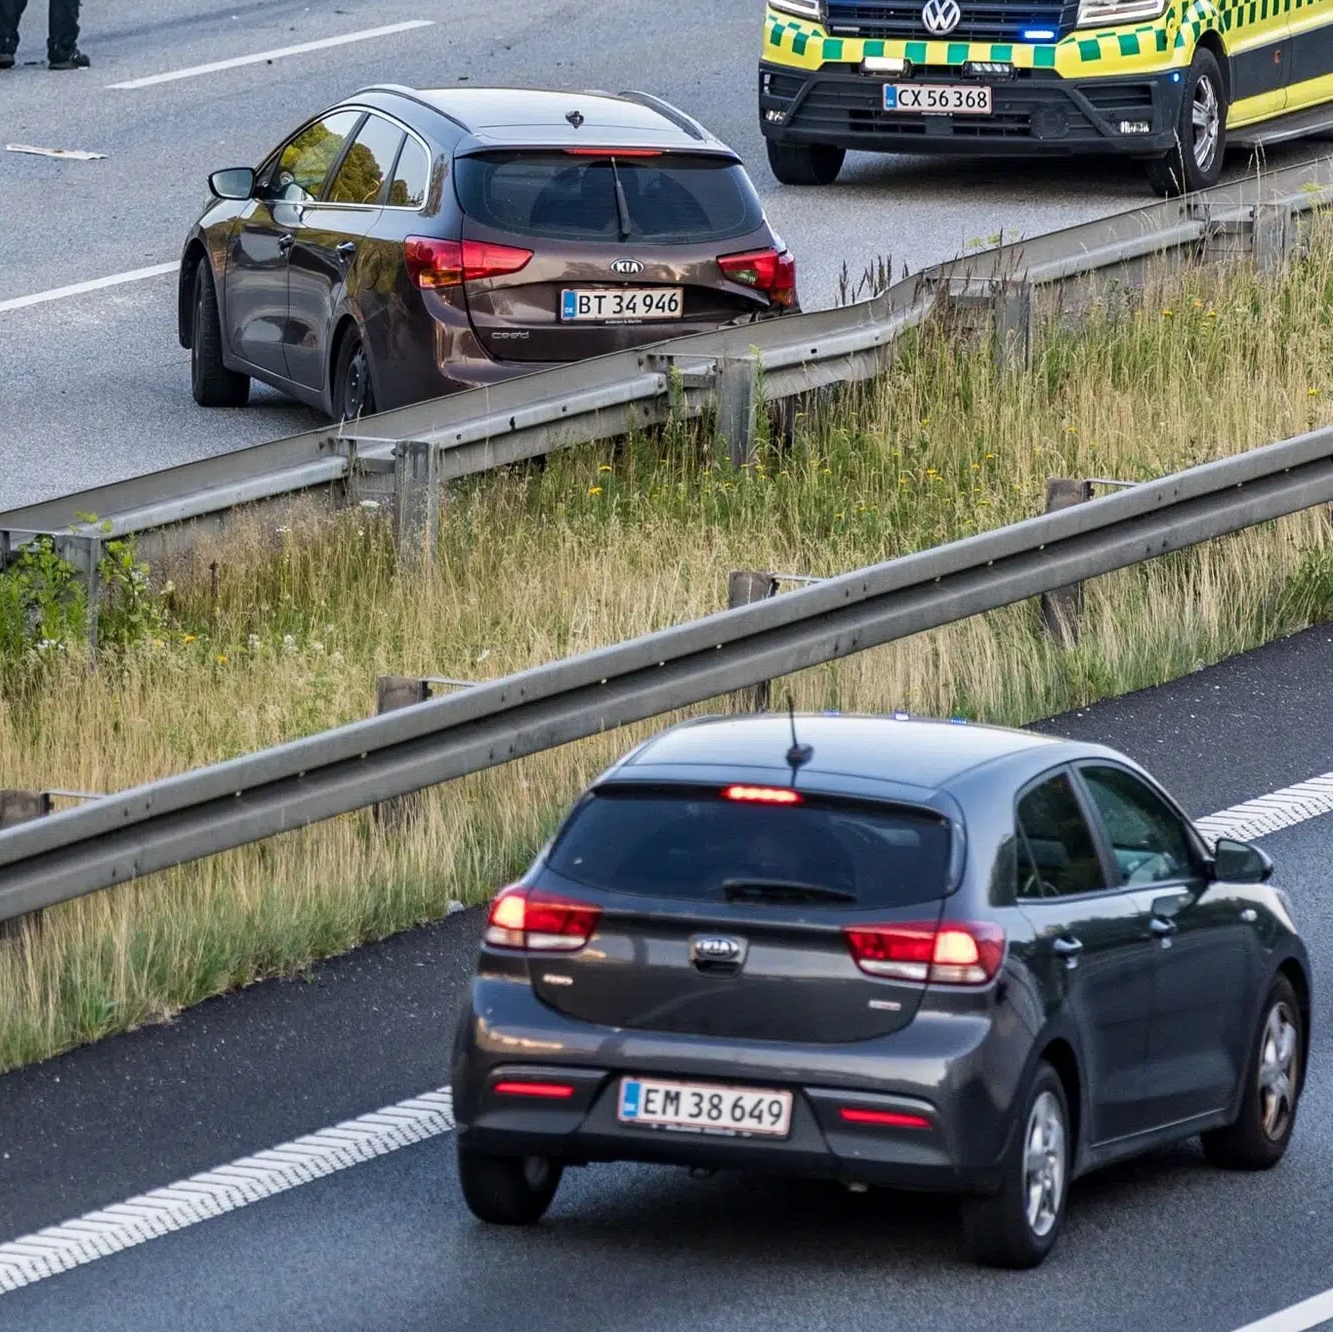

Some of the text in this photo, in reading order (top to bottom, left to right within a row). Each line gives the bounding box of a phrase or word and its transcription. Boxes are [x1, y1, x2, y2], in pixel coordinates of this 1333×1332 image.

[898, 89, 921, 107] CX
[927, 90, 949, 107] 56
[953, 91, 987, 108] 368
[616, 262, 639, 273] KIA
[579, 293, 679, 315] BT 34 946
[644, 1088, 783, 1126] EM 38 649
